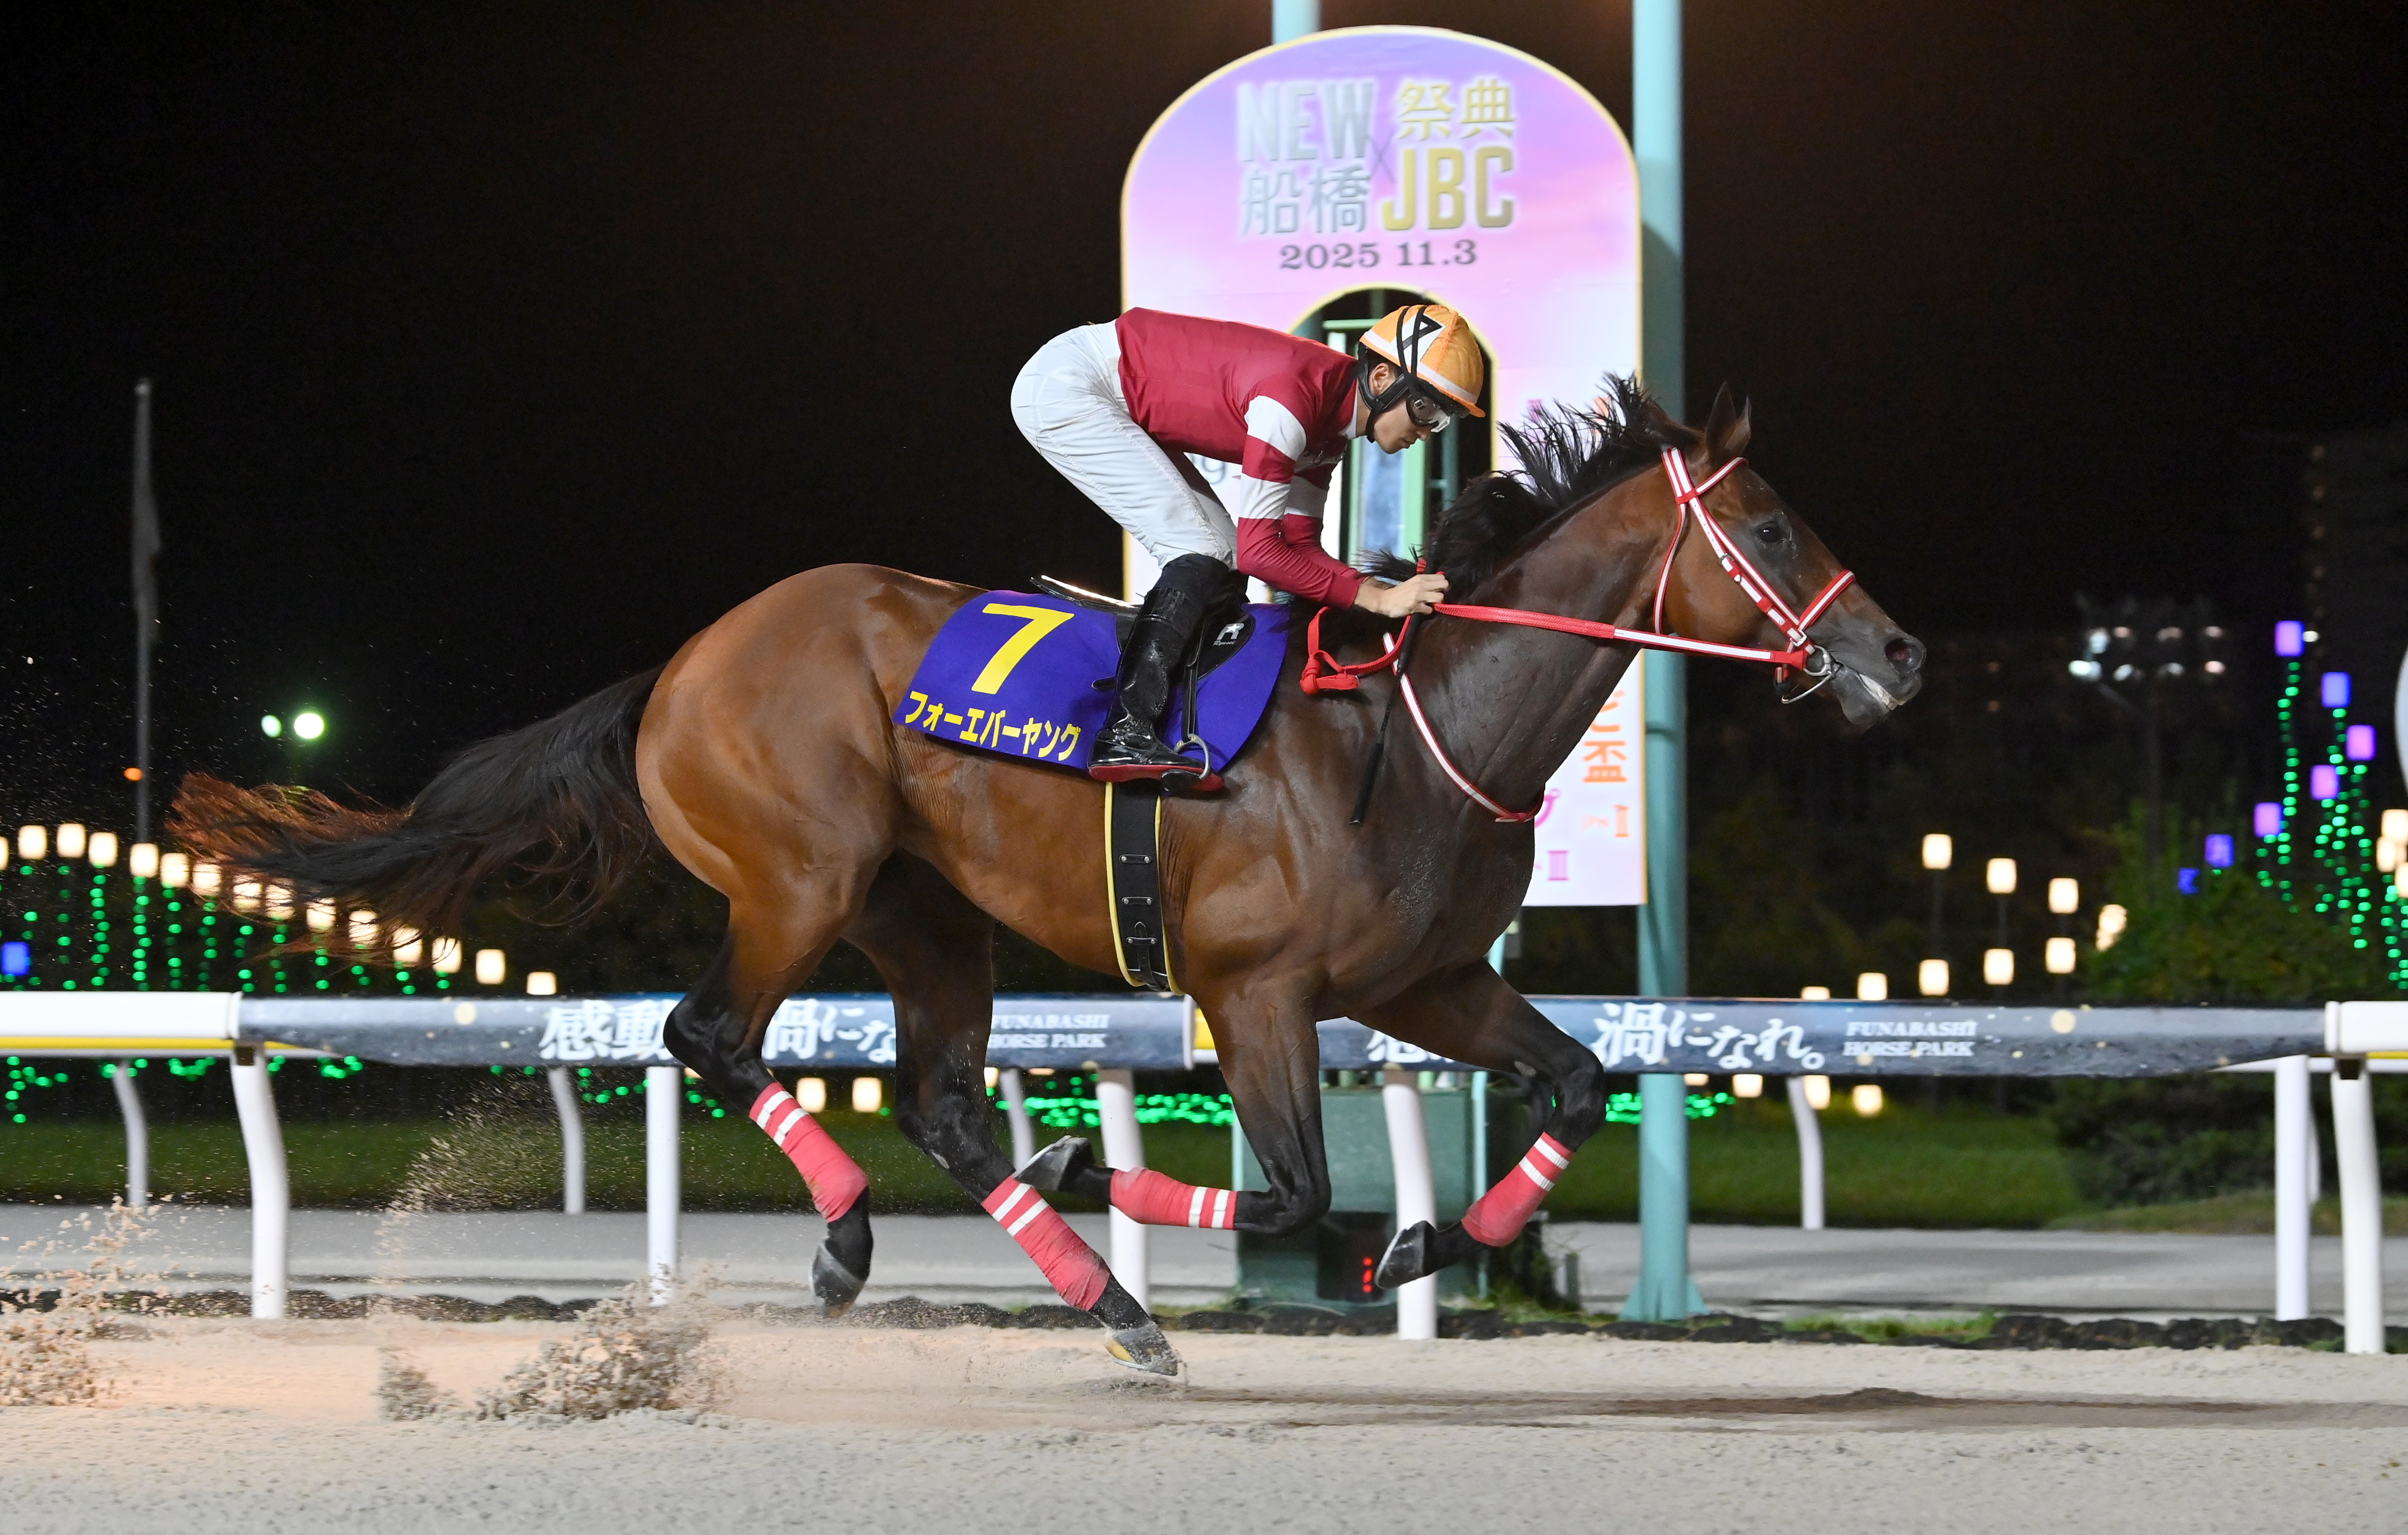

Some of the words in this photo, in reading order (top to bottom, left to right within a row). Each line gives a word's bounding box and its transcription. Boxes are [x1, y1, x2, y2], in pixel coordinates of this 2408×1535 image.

[1239, 80, 1373, 161] NEW
[1397, 79, 1515, 141] 祭典
[1240, 164, 1371, 234] 船橋
[1381, 145, 1513, 231] JBC
[1280, 242, 1380, 269] 2025
[1397, 239, 1477, 266] 11.3
[971, 603, 1075, 695] 7
[904, 690, 1081, 761] フォーエバーヤング
[1050, 1033, 1107, 1048] PARK
[1843, 1041, 1913, 1056] HORSE
[1915, 1041, 1976, 1056] PARK
[1847, 1022, 1979, 1036] FUNABASHI
